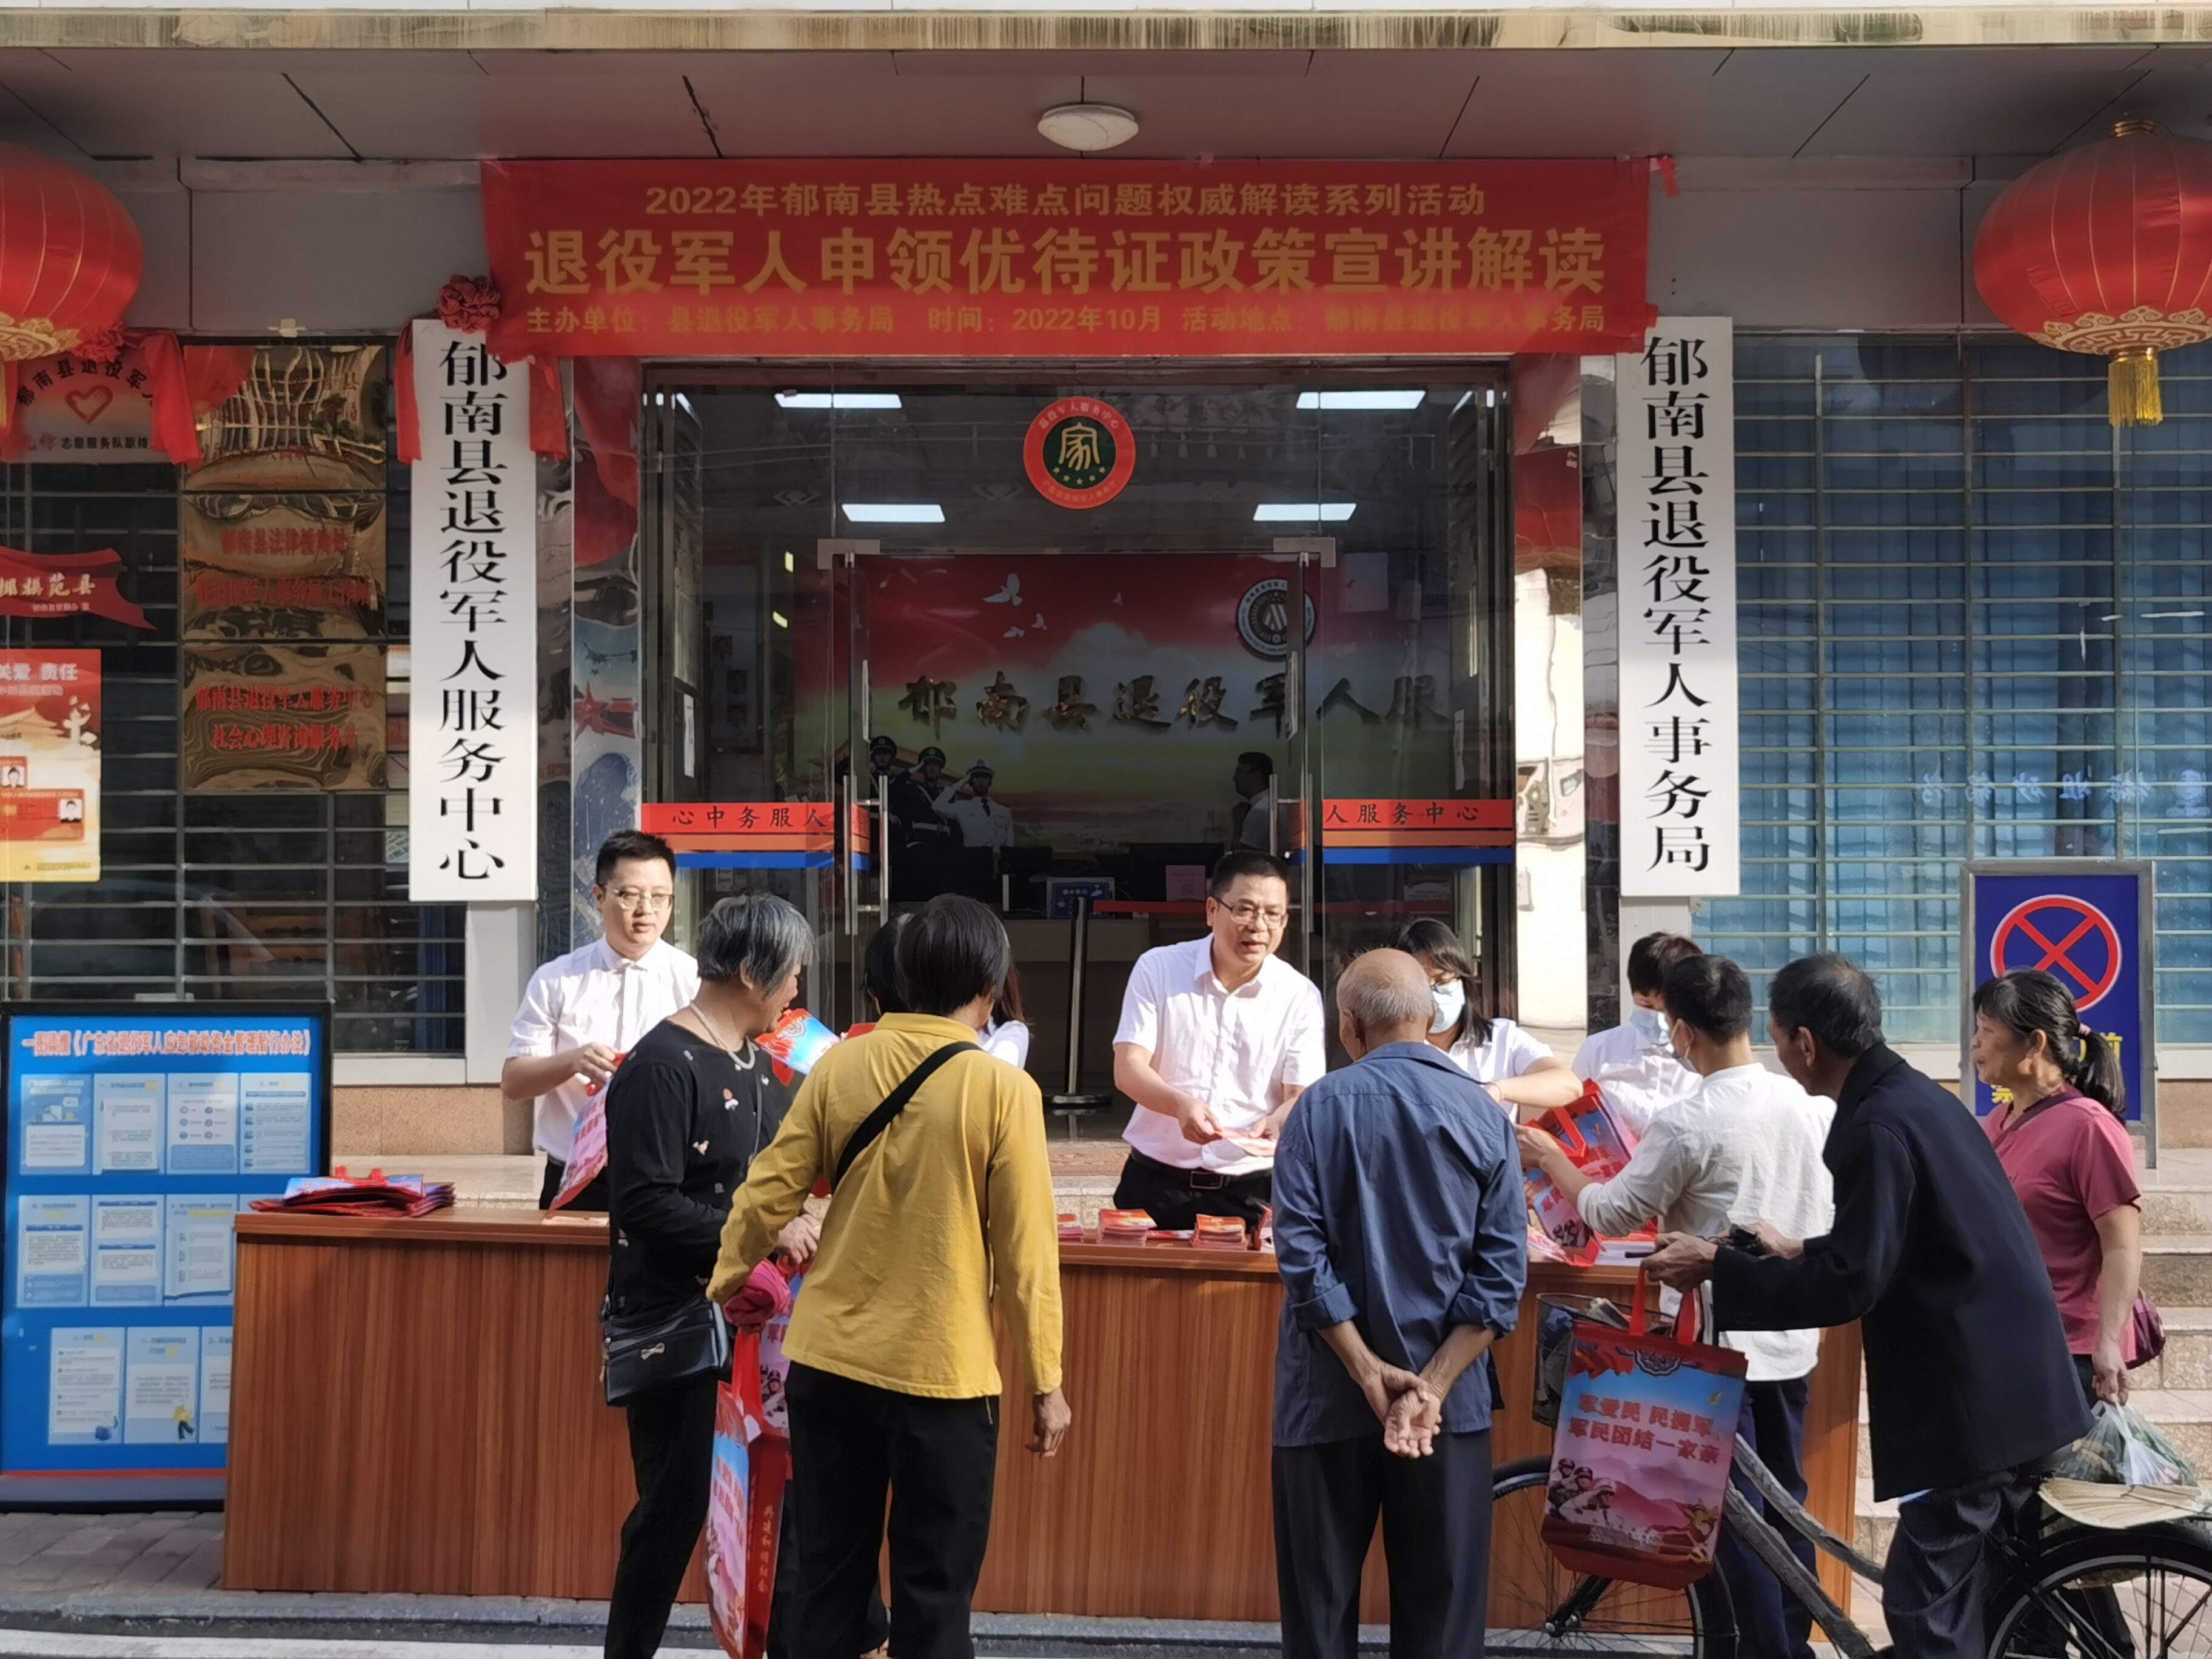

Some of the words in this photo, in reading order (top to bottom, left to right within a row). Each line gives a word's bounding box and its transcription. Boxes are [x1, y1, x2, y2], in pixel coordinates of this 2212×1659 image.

[645, 183, 1486, 218] 2022年郁南县热点难点问题权威解读系列活动
[524, 226, 1606, 295] 退役军人申领优待证政策宣讲解读
[1057, 421, 1102, 472] 家
[438, 340, 508, 883] 郁南县退役军人服务中心
[1638, 335, 1712, 873] 郁南县退役军人事务局
[1324, 801, 1480, 825] 人服务中心
